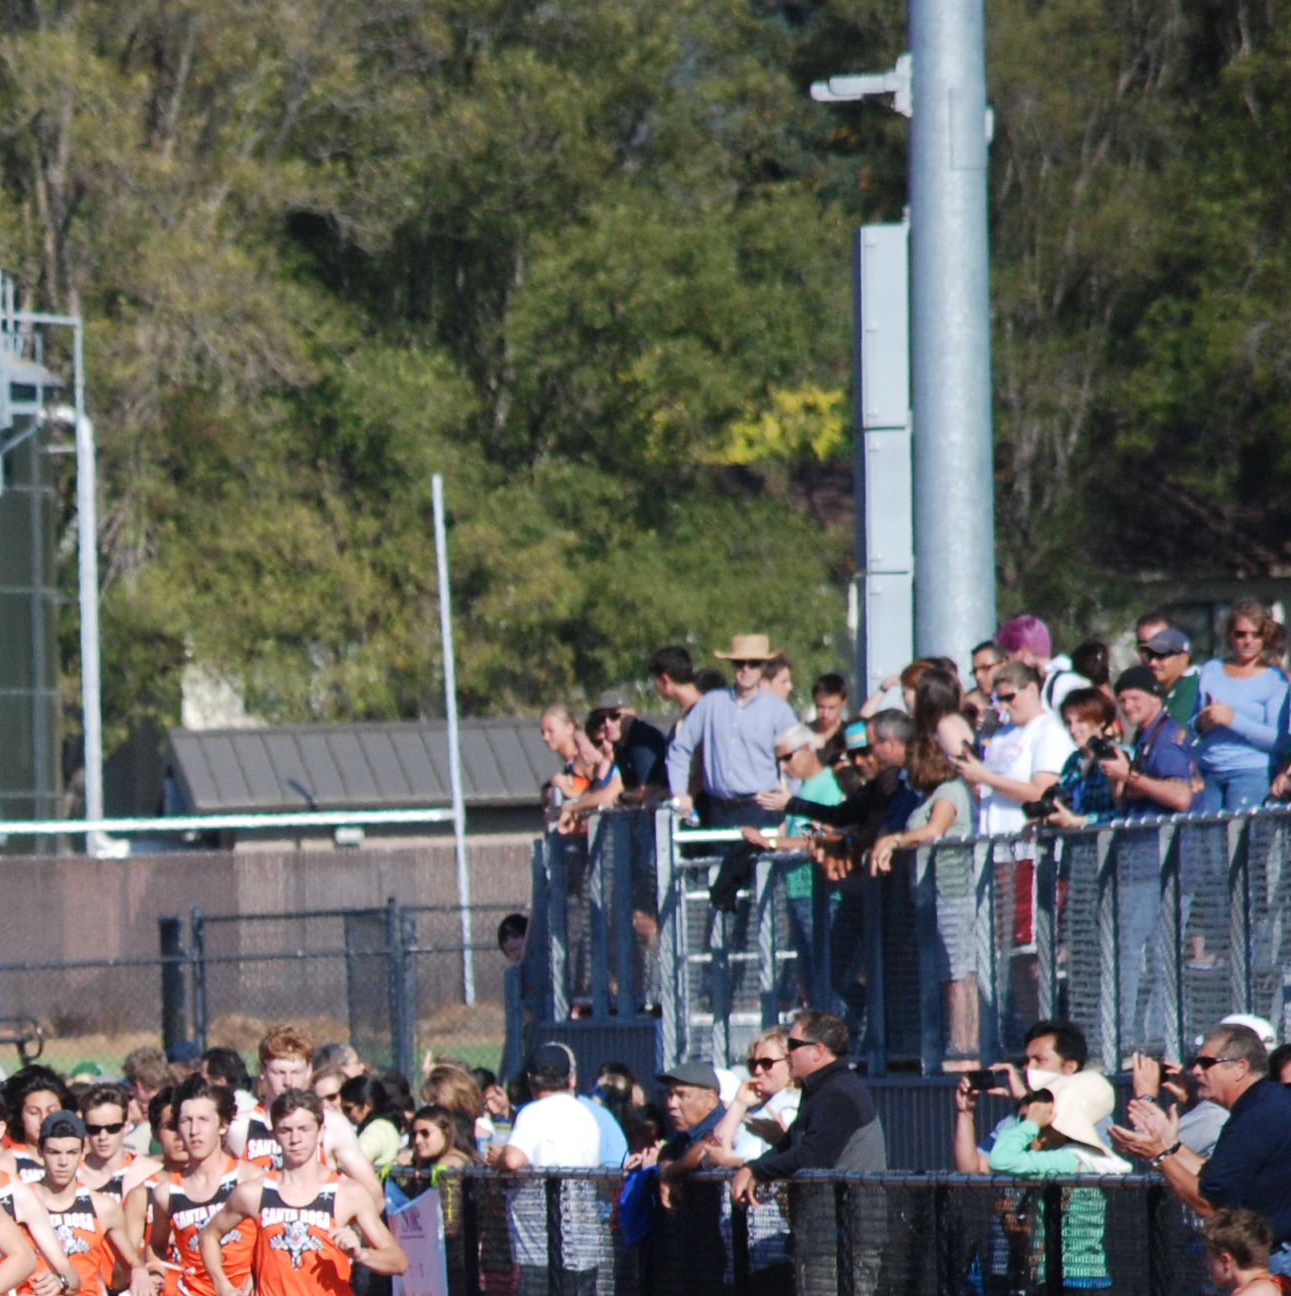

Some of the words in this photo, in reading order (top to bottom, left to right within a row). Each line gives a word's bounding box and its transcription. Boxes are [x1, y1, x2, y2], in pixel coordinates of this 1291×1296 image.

[64, 1213, 95, 1232] ROSA
[261, 1208, 299, 1228] SANTA
[301, 1210, 331, 1229] ROSA
